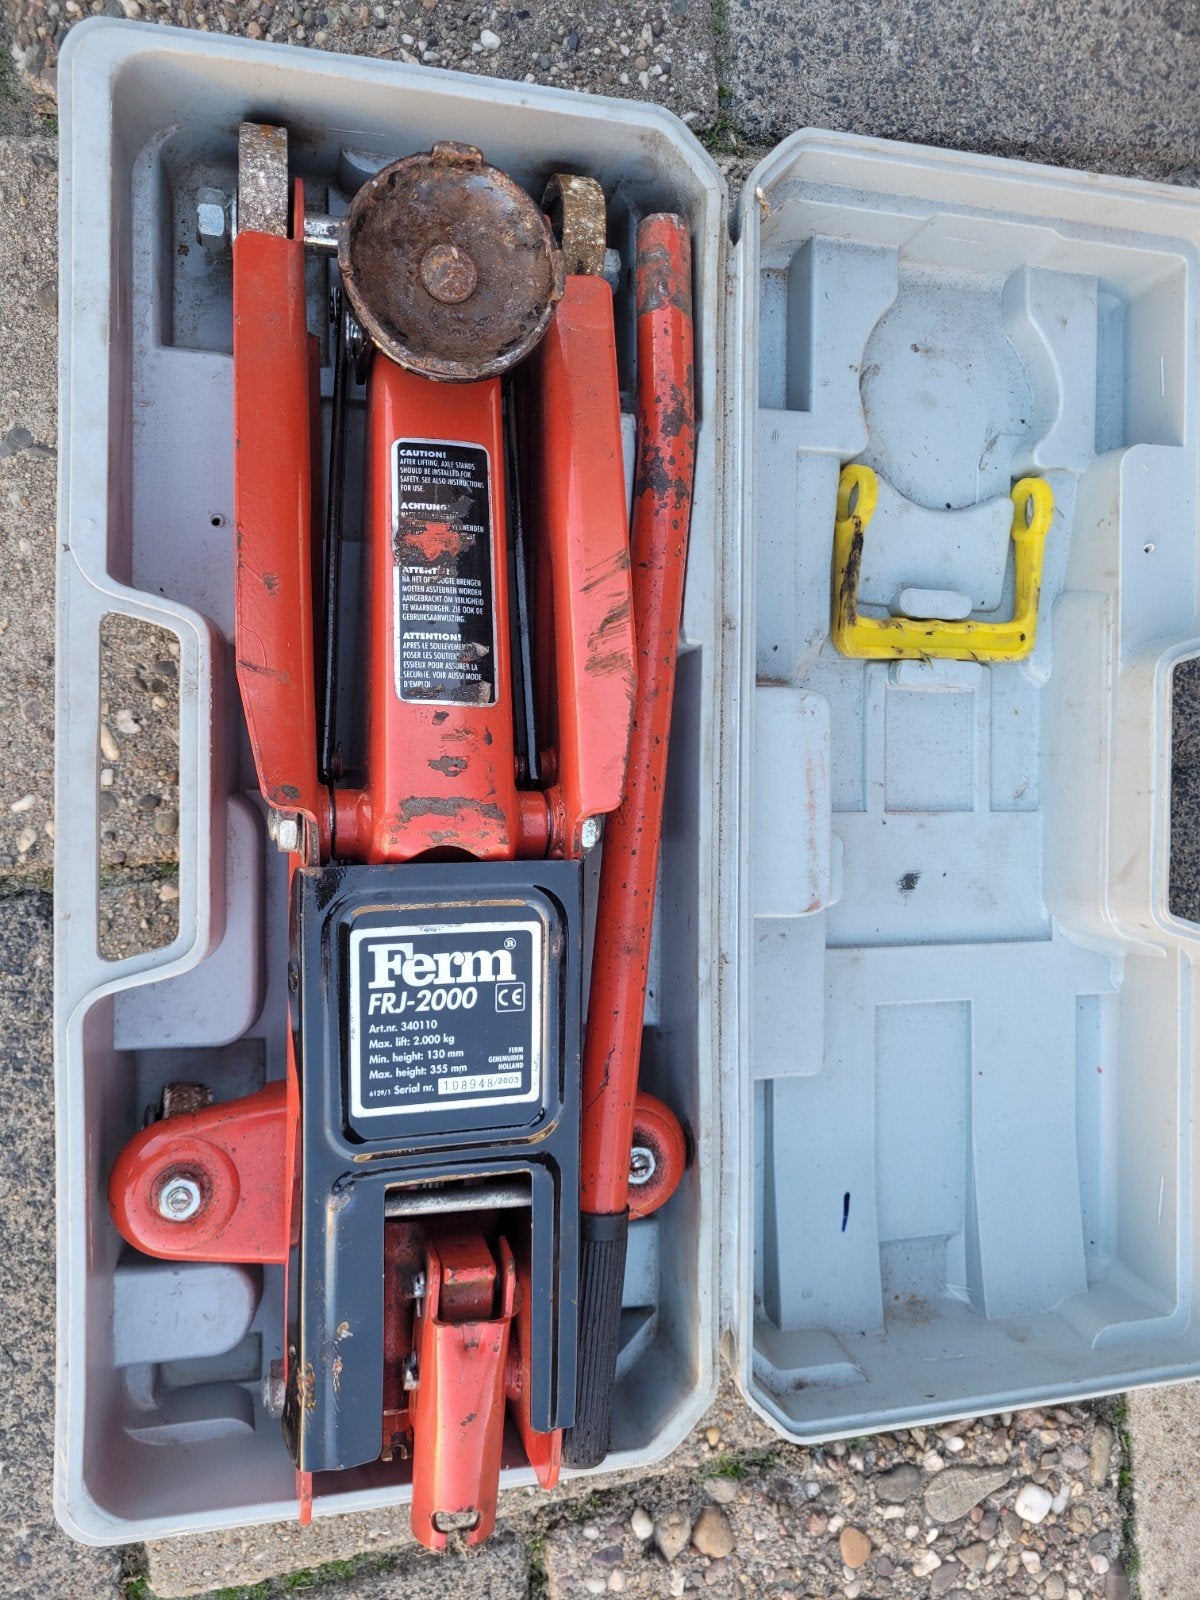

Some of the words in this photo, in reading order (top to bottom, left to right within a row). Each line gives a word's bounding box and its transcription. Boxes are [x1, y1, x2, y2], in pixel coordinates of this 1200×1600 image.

[399, 450, 446, 458] CAUTION!
[456, 462, 475, 470] STANDS
[448, 479, 484, 488] INSTRUCTIONS
[457, 578, 481, 586] BRENGEN
[426, 586, 457, 594] ASSTEUNEN
[455, 597, 484, 606] VEILIGHEID
[411, 604, 450, 612] WAARBORGEN.
[402, 614, 466, 623] GEBRUIKSAANWIJZING.
[403, 632, 462, 641] ATTENTION!
[368, 942, 516, 990] Ferm
[368, 987, 477, 1015] FRJ-2000
[369, 1023, 398, 1034] Art.nr.
[401, 1020, 437, 1031] 340110
[369, 1040, 392, 1049] Max.
[396, 1037, 410, 1046] lift:
[413, 1035, 440, 1045] 2.000
[443, 1034, 455, 1045] kg
[369, 1055, 389, 1065] Min.
[392, 1051, 423, 1064] height:
[427, 1050, 444, 1059] 130
[447, 1050, 464, 1058] mm
[498, 1062, 524, 1070] HOLLAND
[369, 1070, 392, 1080] Max.
[396, 1066, 426, 1078] height:
[430, 1065, 448, 1074] 355
[451, 1065, 467, 1073] mm
[394, 1083, 420, 1094] Serial
[423, 1083, 434, 1092] nr.
